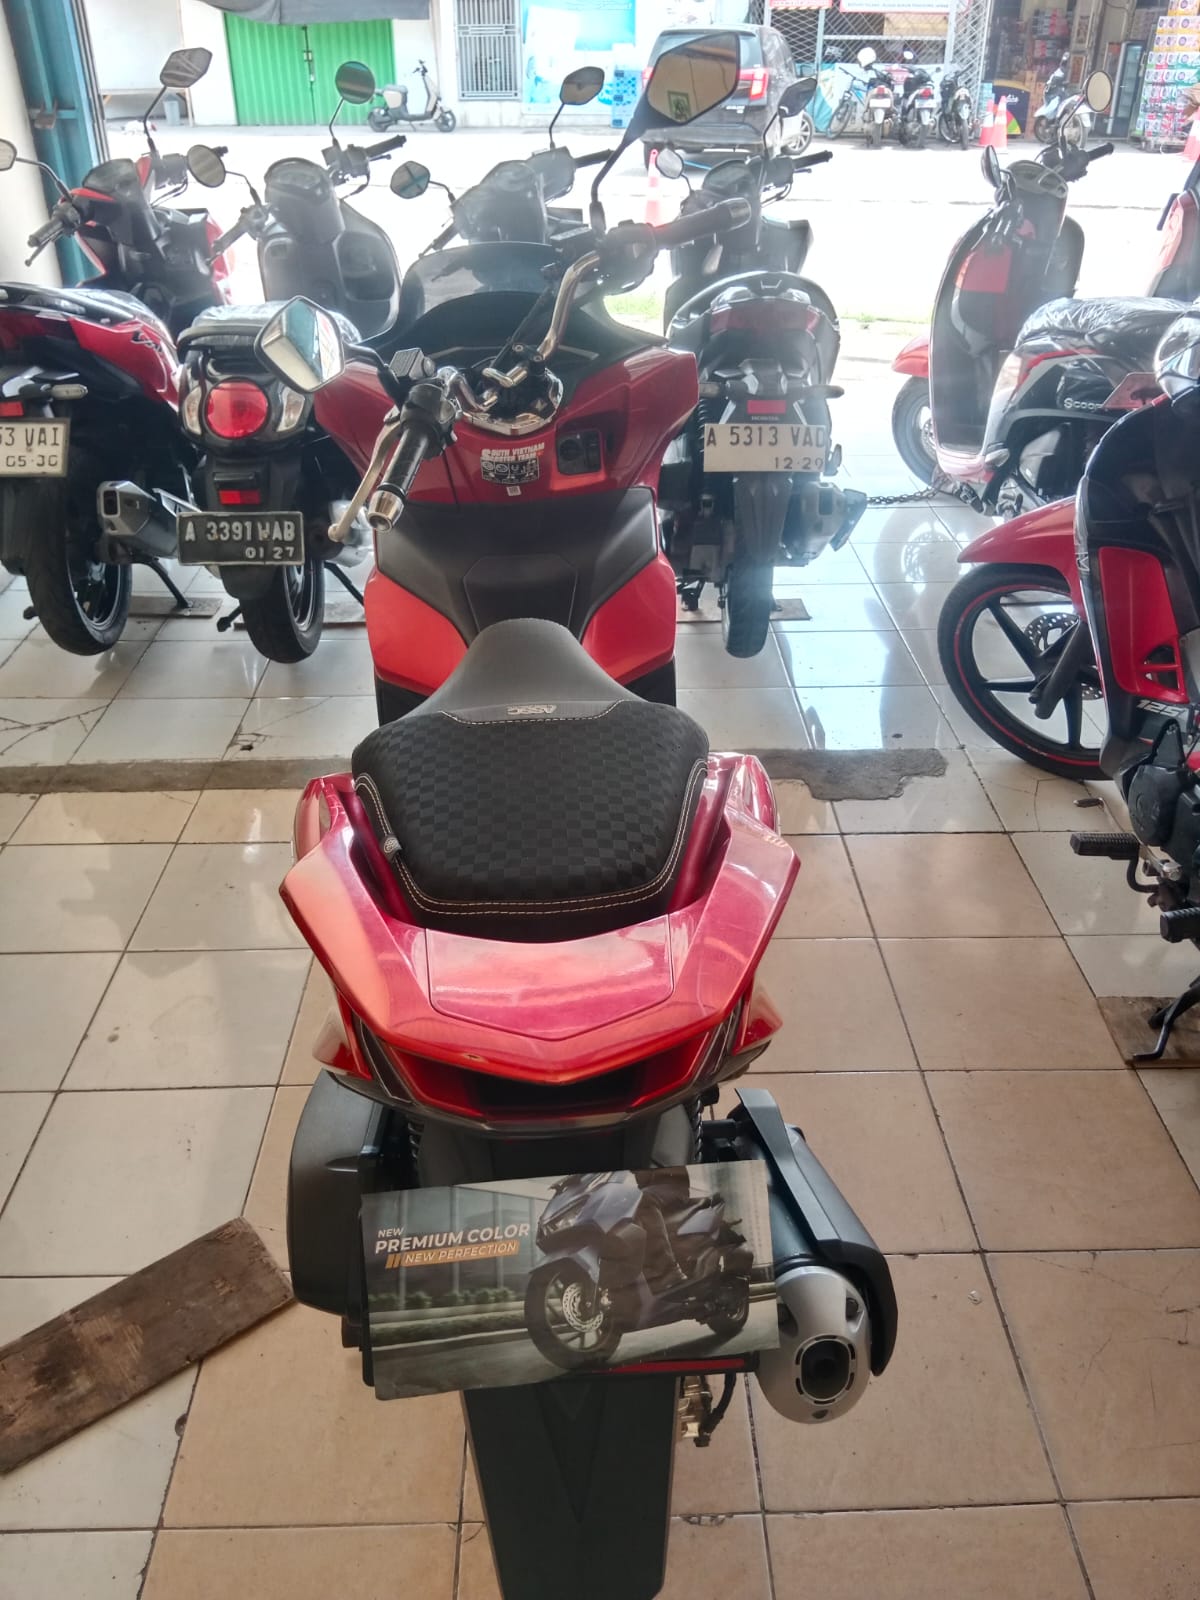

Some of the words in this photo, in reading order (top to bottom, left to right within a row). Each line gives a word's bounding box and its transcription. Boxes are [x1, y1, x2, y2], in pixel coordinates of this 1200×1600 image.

[1064, 398, 1108, 412] Scoop
[0, 427, 15, 446] 3
[25, 427, 60, 447] VAI
[706, 426, 717, 447] A
[730, 426, 778, 446] 5313
[185, 521, 196, 541] A
[206, 521, 252, 541] 3391
[375, 1231, 463, 1255] PREMIUM
[467, 1223, 531, 1243] COLOR
[377, 1227, 404, 1239] NEW
[404, 1252, 435, 1265] NEW
[438, 1244, 517, 1262] PERFECTION
